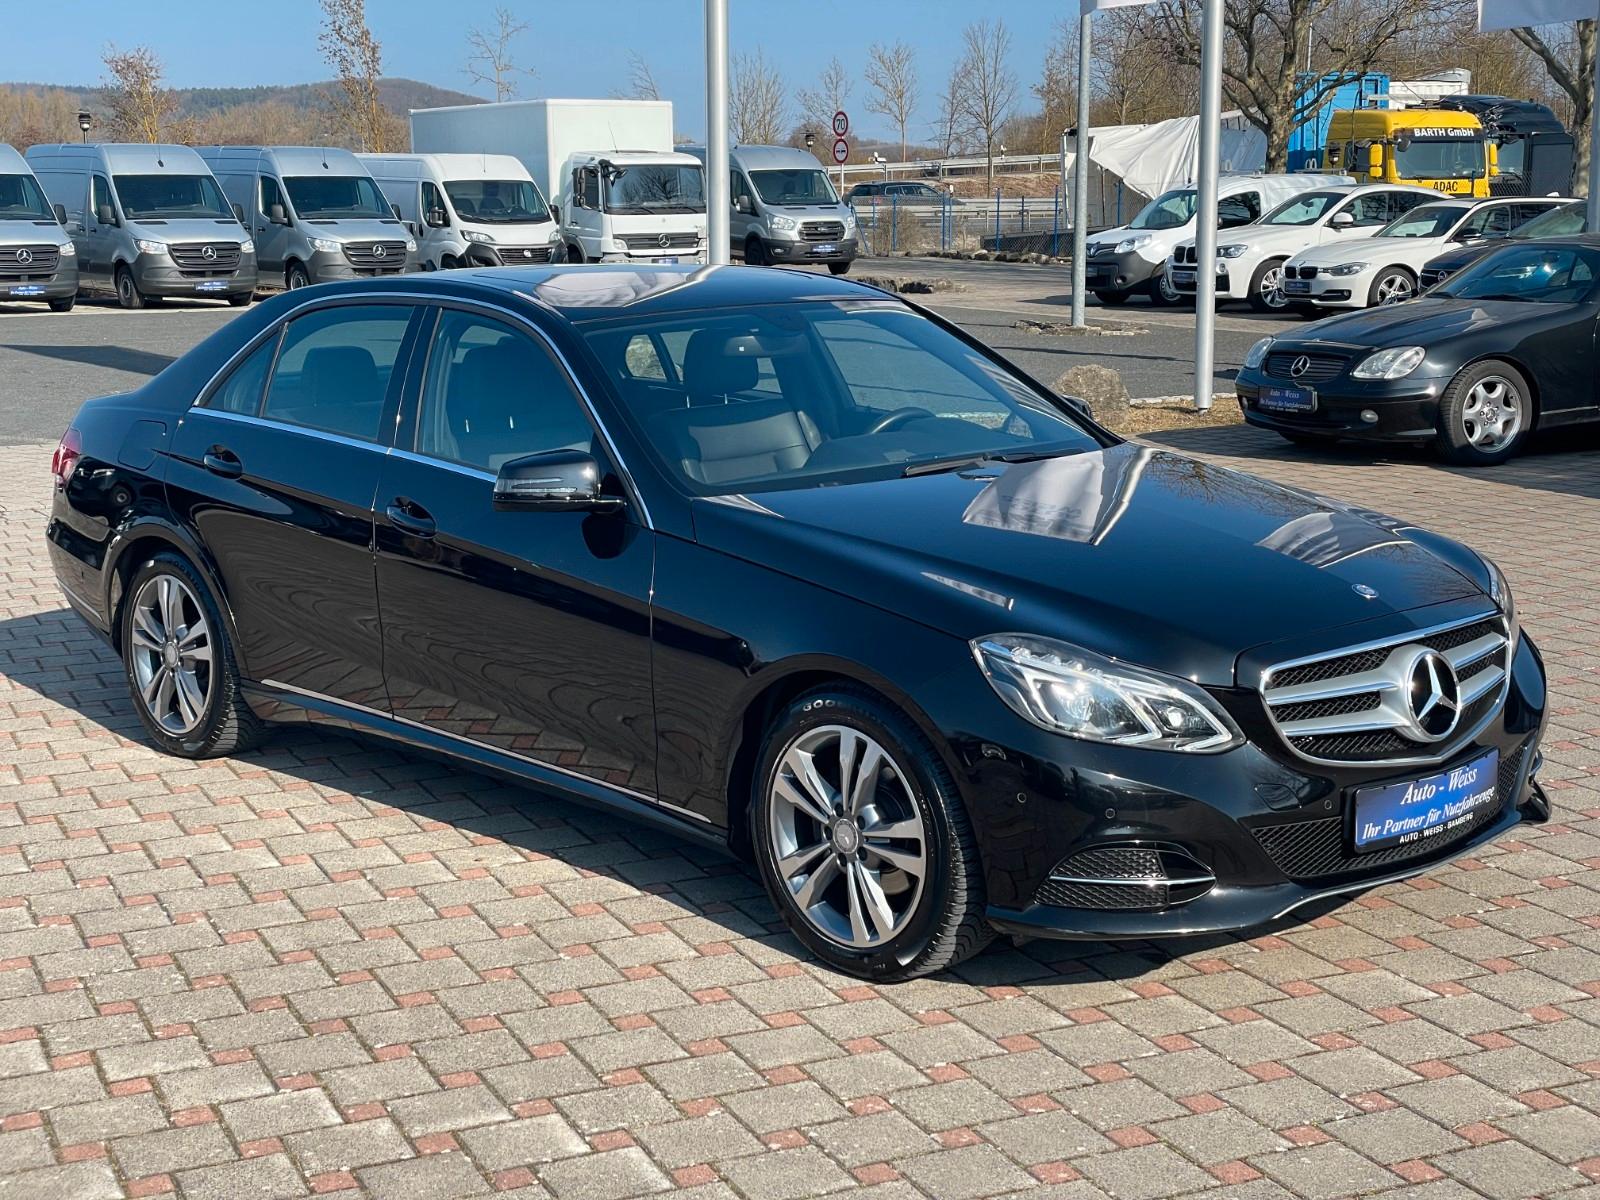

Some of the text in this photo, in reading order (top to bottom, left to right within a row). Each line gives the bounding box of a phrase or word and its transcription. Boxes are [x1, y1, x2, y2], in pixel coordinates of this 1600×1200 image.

[836, 118, 845, 130] 70
[1414, 128, 1475, 137] BARTH GmbH
[1433, 181, 1458, 192] ADAC
[1400, 784, 1436, 805] Auto
[1448, 768, 1478, 792] Weiss
[1362, 786, 1495, 840] Ihr Partner für Nutzfahrzeuge
[1399, 831, 1419, 844] AUTO
[1423, 824, 1444, 837] WEISS
[1447, 812, 1474, 829] BAMBERG
